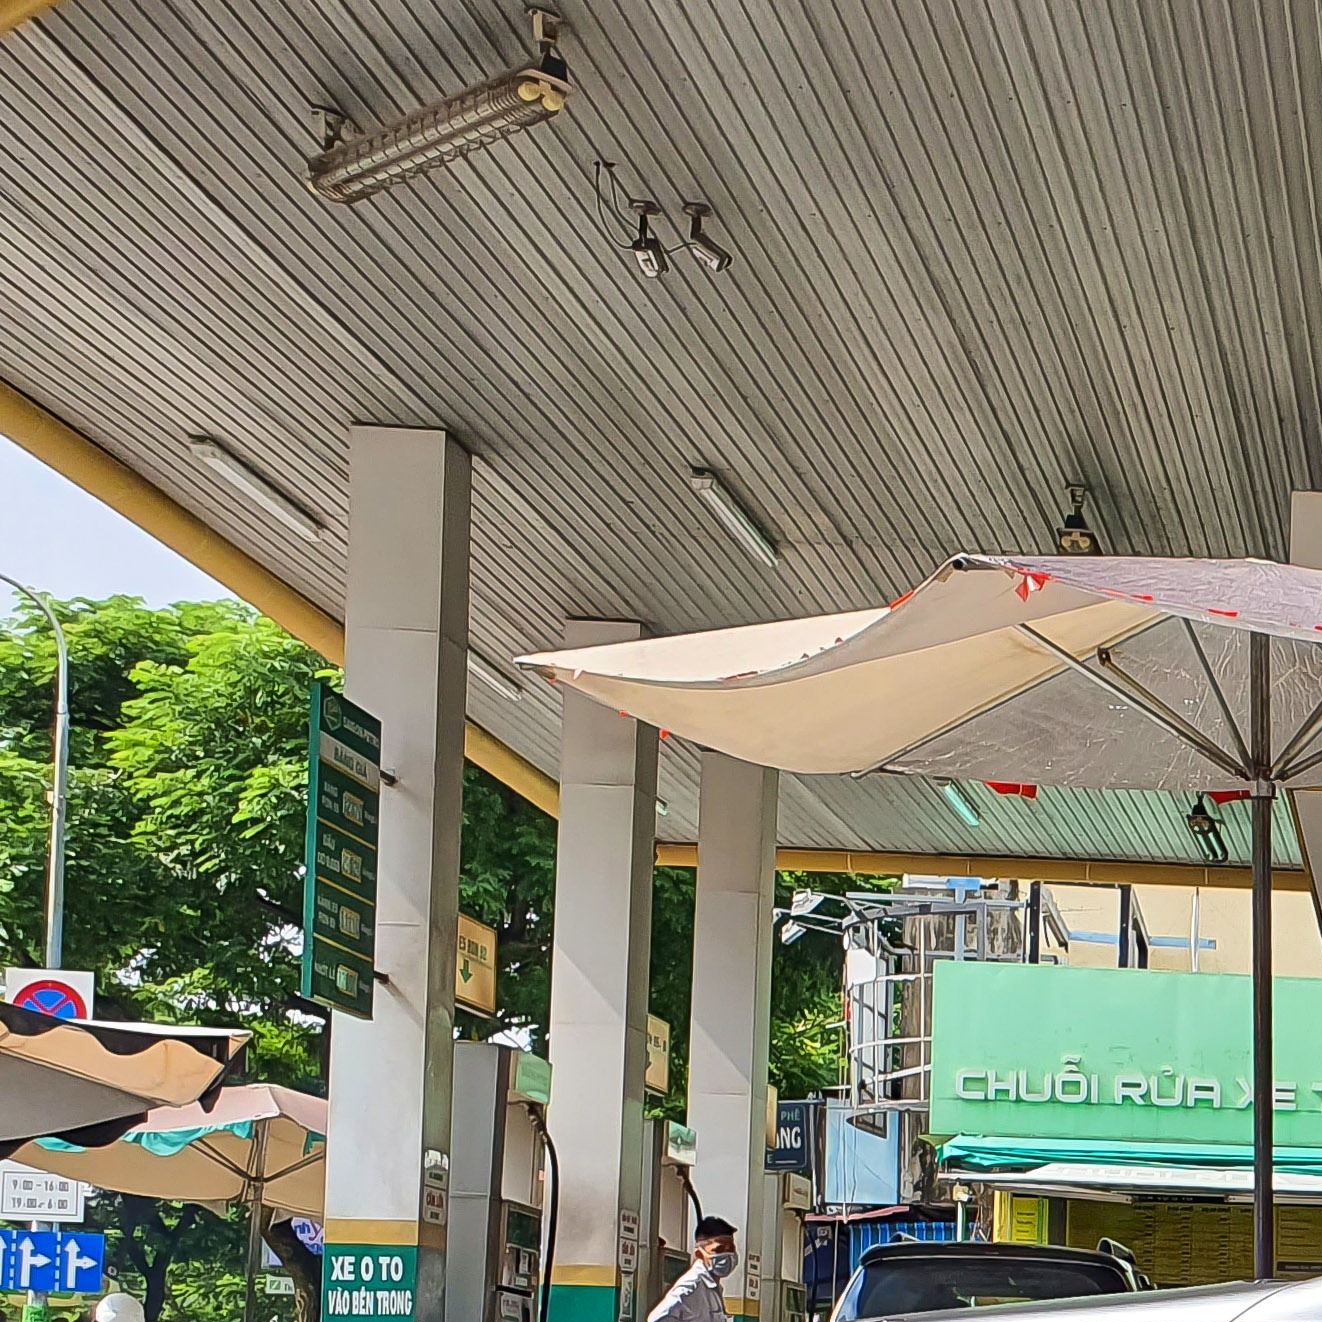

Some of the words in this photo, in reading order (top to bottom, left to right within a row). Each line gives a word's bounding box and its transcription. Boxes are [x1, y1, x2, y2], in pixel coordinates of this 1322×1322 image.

[955, 1055, 1098, 1104] CHUỖI
[1114, 1065, 1222, 1109] RỬA
[330, 1255, 356, 1281] XE
[360, 1255, 374, 1282] O
[378, 1255, 404, 1282] TO
[328, 1286, 350, 1316] VÀO
[376, 1289, 413, 1316] TRONG
